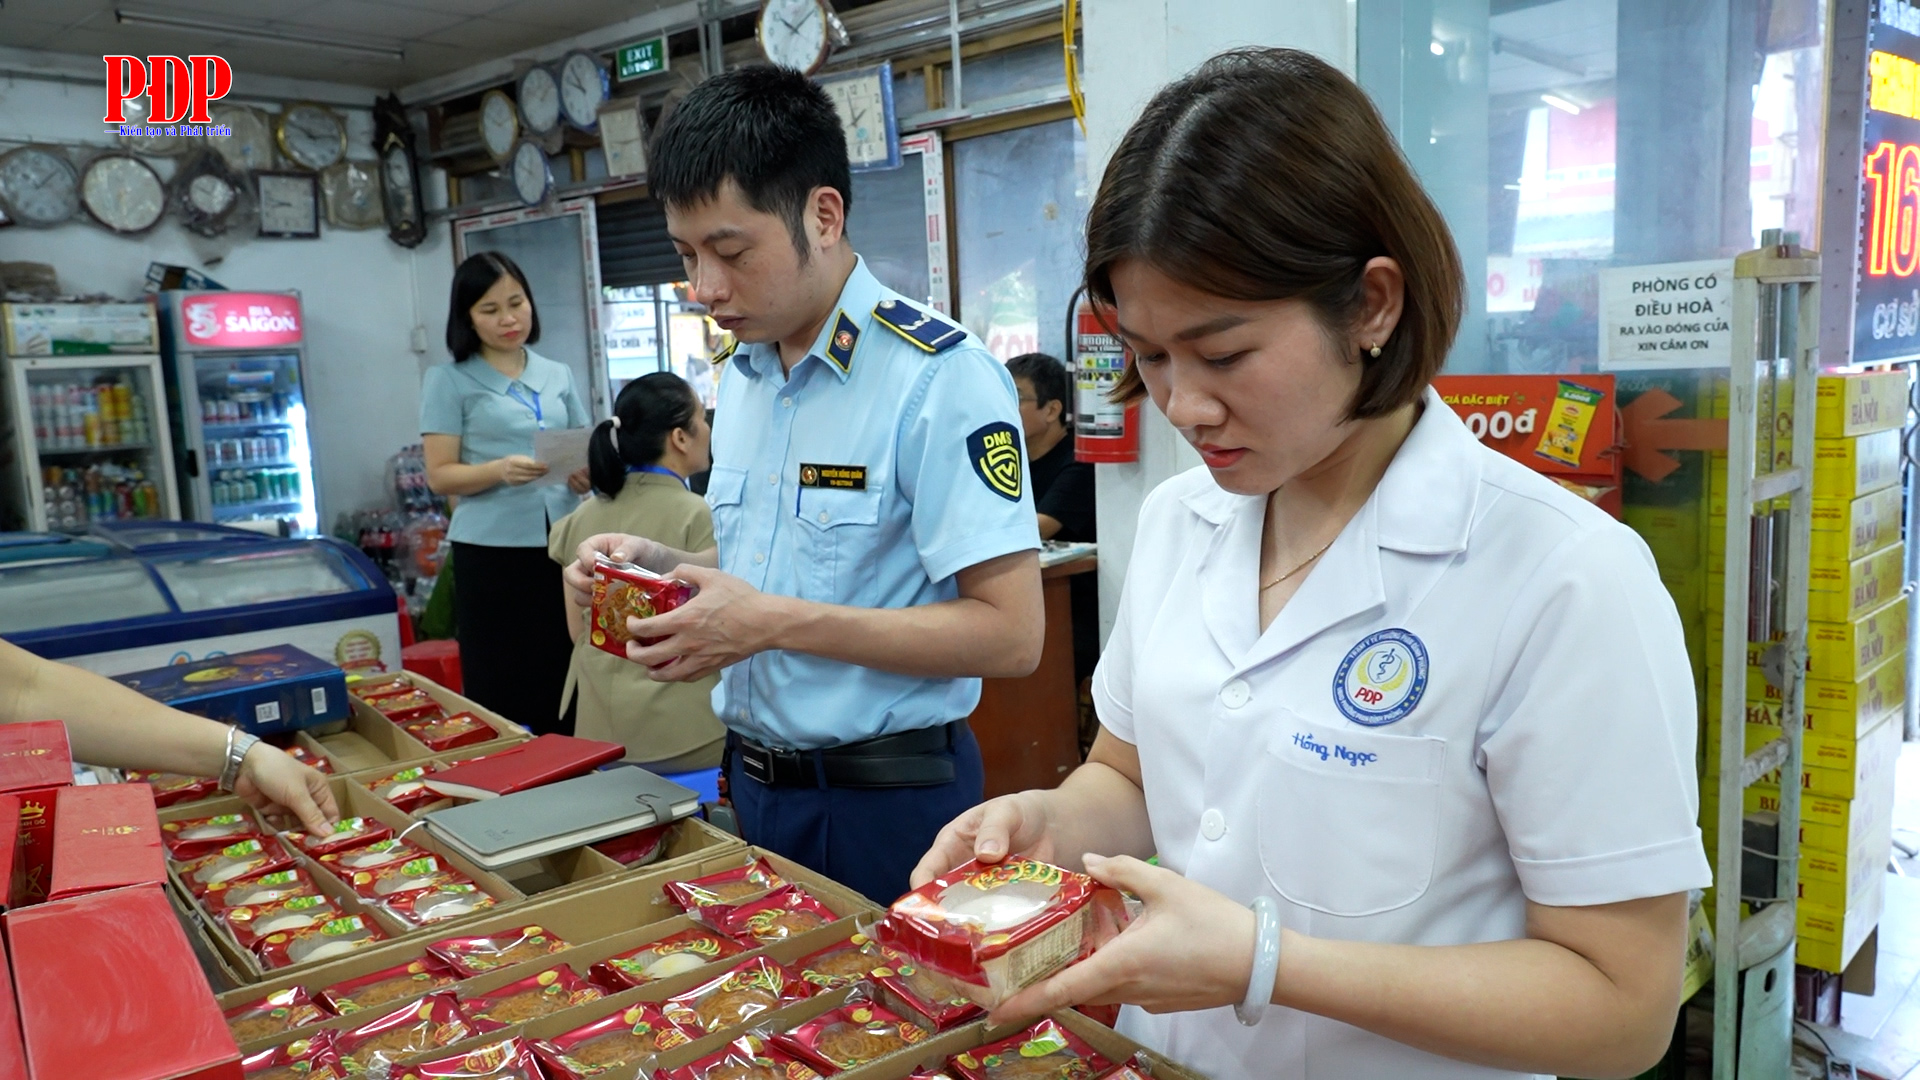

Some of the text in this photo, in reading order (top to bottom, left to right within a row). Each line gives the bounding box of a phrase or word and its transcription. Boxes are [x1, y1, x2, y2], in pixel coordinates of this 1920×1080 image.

[626, 44, 653, 62] EXIT
[1632, 273, 1717, 293] PHÒNG CÓ
[1635, 297, 1713, 316] ĐIỀU HOÀ
[225, 316, 297, 332] SAIGON
[1620, 326, 1635, 336] RA
[1638, 323, 1662, 335] VÀO
[1638, 342, 1657, 351] XIN
[1442, 394, 1510, 407] GIÁ ĐẶC BIỆT
[1464, 408, 1538, 440] 00đ
[983, 431, 1012, 449] DMS
[1355, 687, 1383, 705] PDP
[1765, 685, 1784, 699] BI
[1292, 733, 1378, 766] Hồng Ngọc
